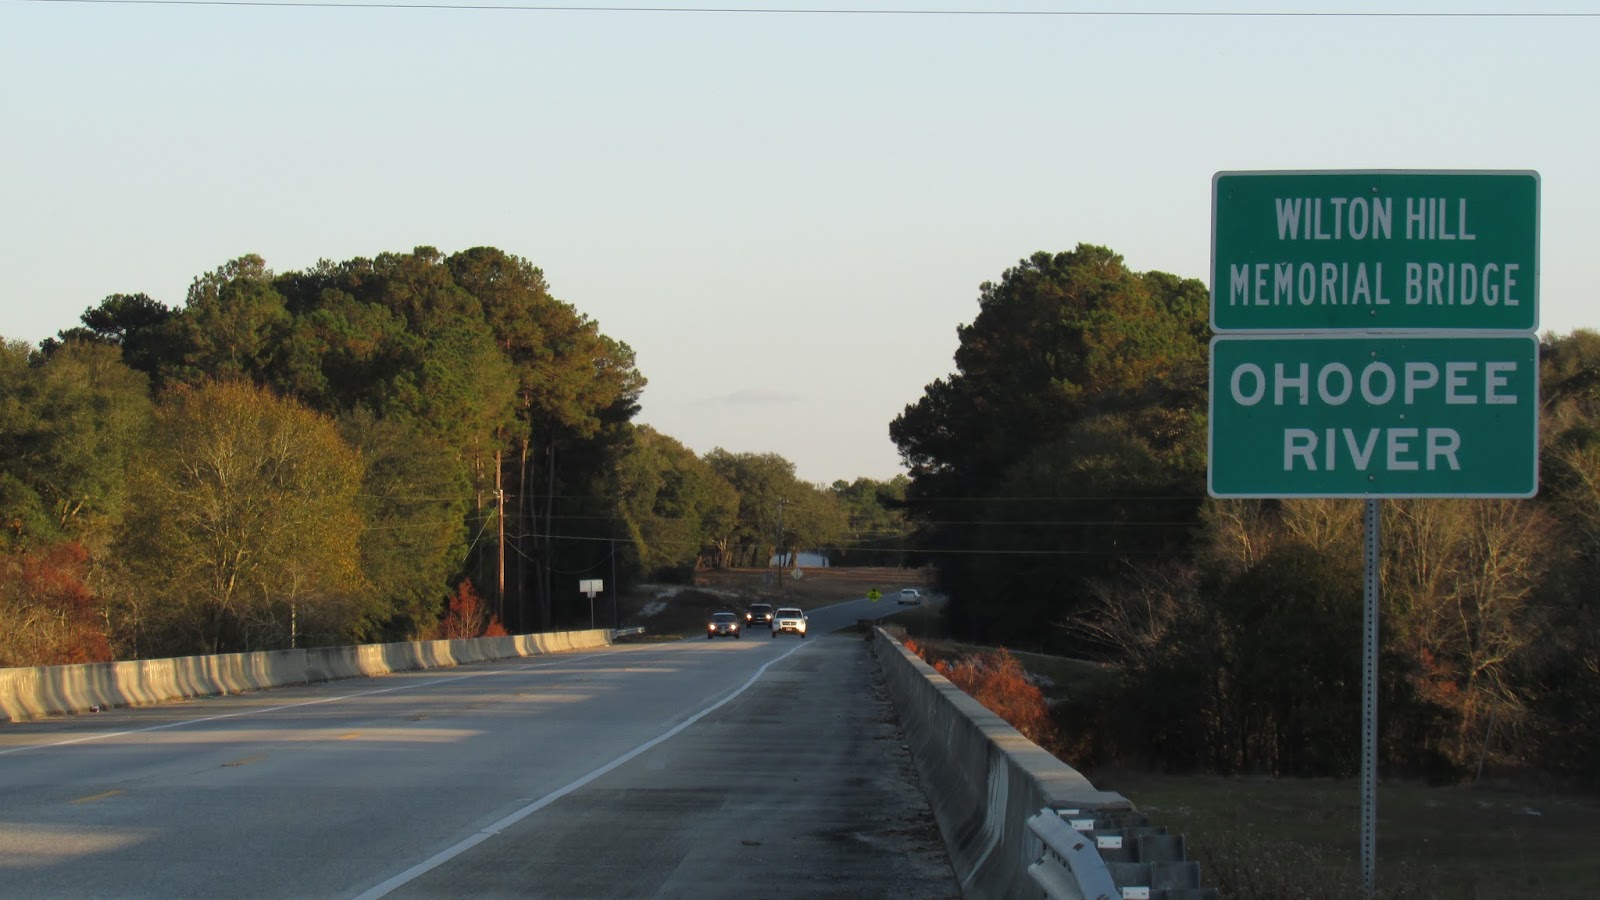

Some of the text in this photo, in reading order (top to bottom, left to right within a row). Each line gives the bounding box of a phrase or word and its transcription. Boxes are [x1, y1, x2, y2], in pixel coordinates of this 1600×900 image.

[1275, 197, 1476, 240] WILTON HILL
[1229, 262, 1520, 306] MEMORIAL BRIDGE
[1230, 361, 1518, 406] OHOOPEE
[1283, 427, 1461, 471] RIVER
